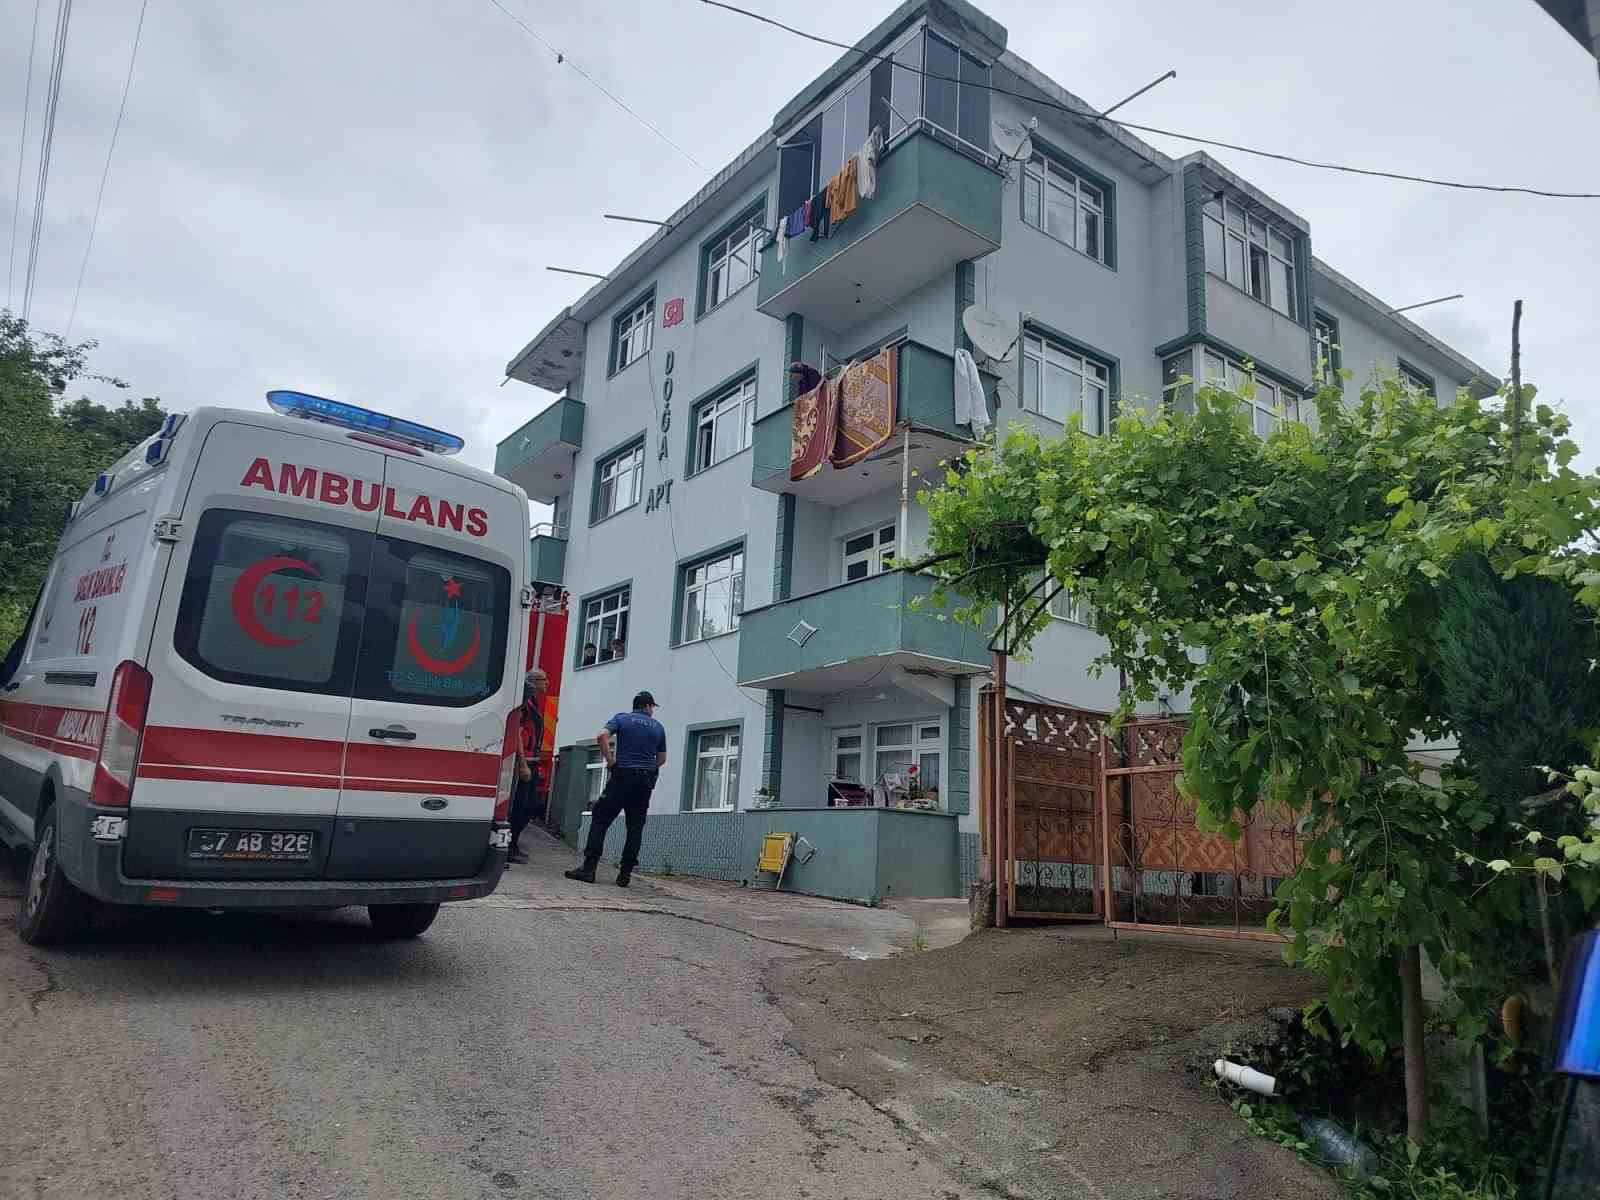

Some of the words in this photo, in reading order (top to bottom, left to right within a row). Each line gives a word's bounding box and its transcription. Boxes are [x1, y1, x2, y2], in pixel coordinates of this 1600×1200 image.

[240, 457, 488, 537] AMBULANS
[646, 478, 673, 514] APT
[258, 582, 325, 624] 112
[75, 605, 97, 656] 112
[220, 714, 304, 729] TRANSIT
